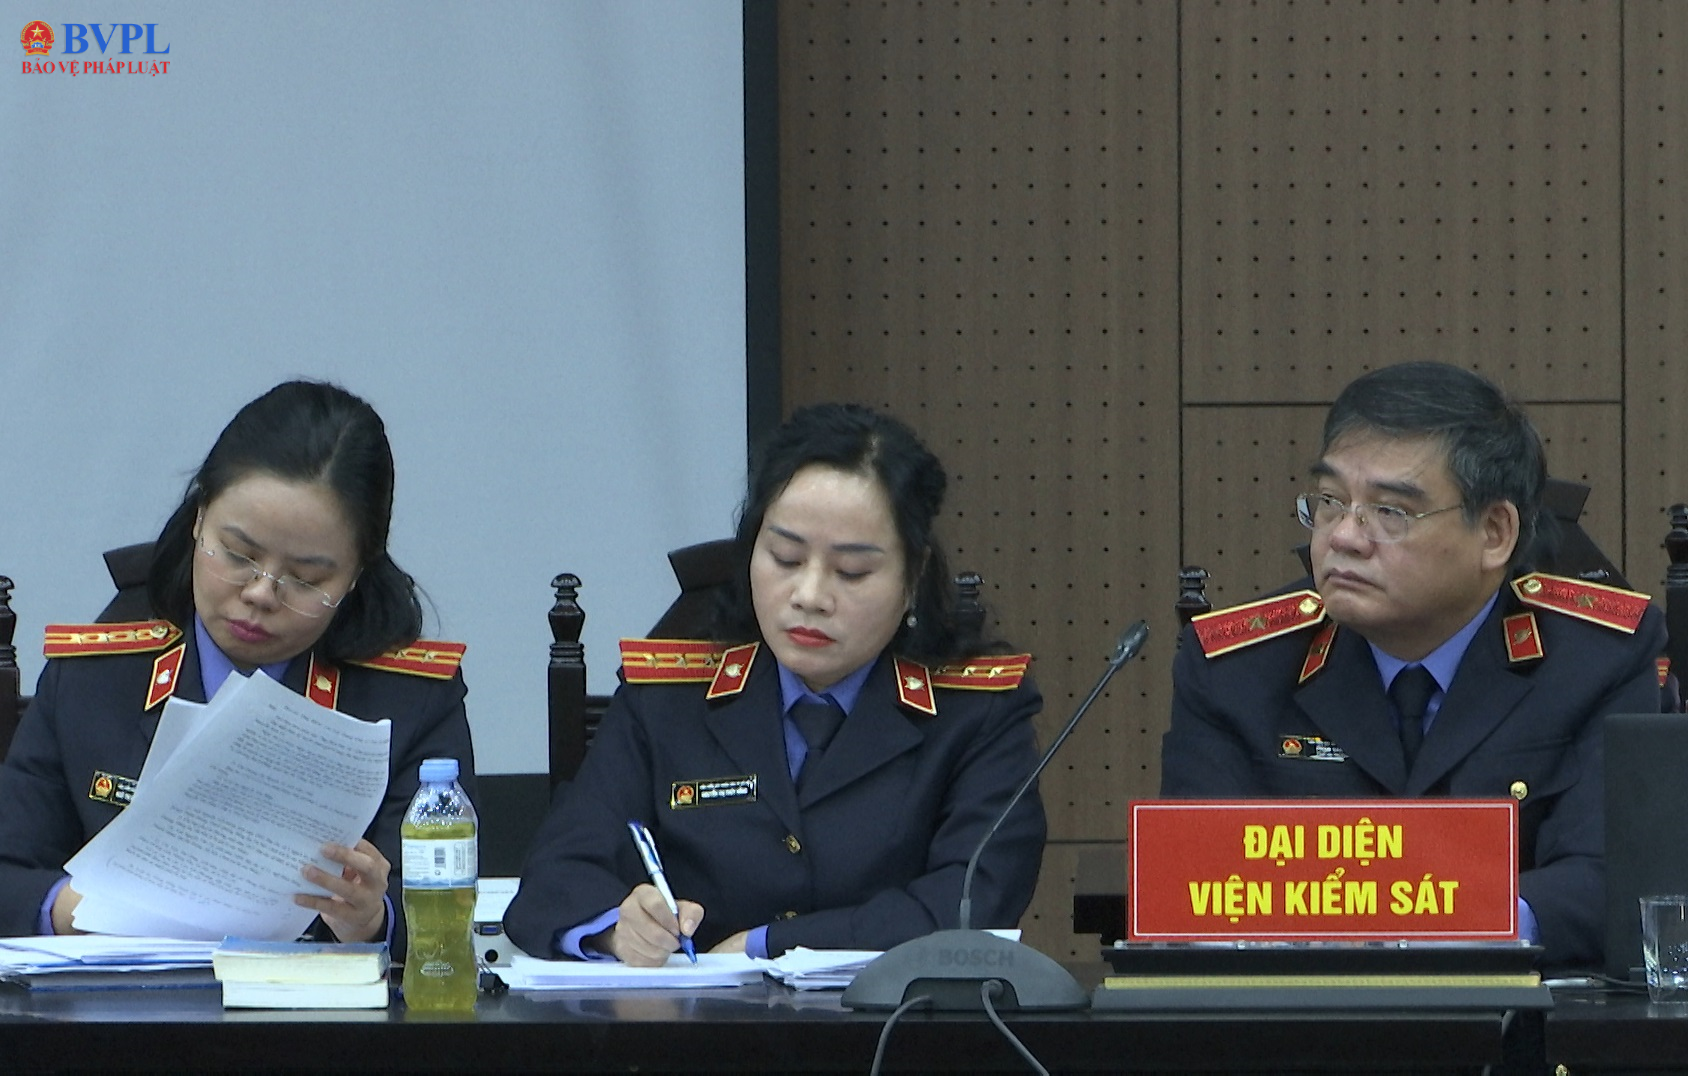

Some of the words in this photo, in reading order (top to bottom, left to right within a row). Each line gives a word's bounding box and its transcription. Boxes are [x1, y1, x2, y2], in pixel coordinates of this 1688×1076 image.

[1243, 824, 1305, 866] ĐẠI
[1317, 816, 1403, 866] DIỆN
[1188, 874, 1273, 923] VIỆN
[1284, 867, 1378, 916] KIỂM
[1389, 873, 1459, 915] SÁT
[938, 948, 1014, 966] BOSCH
